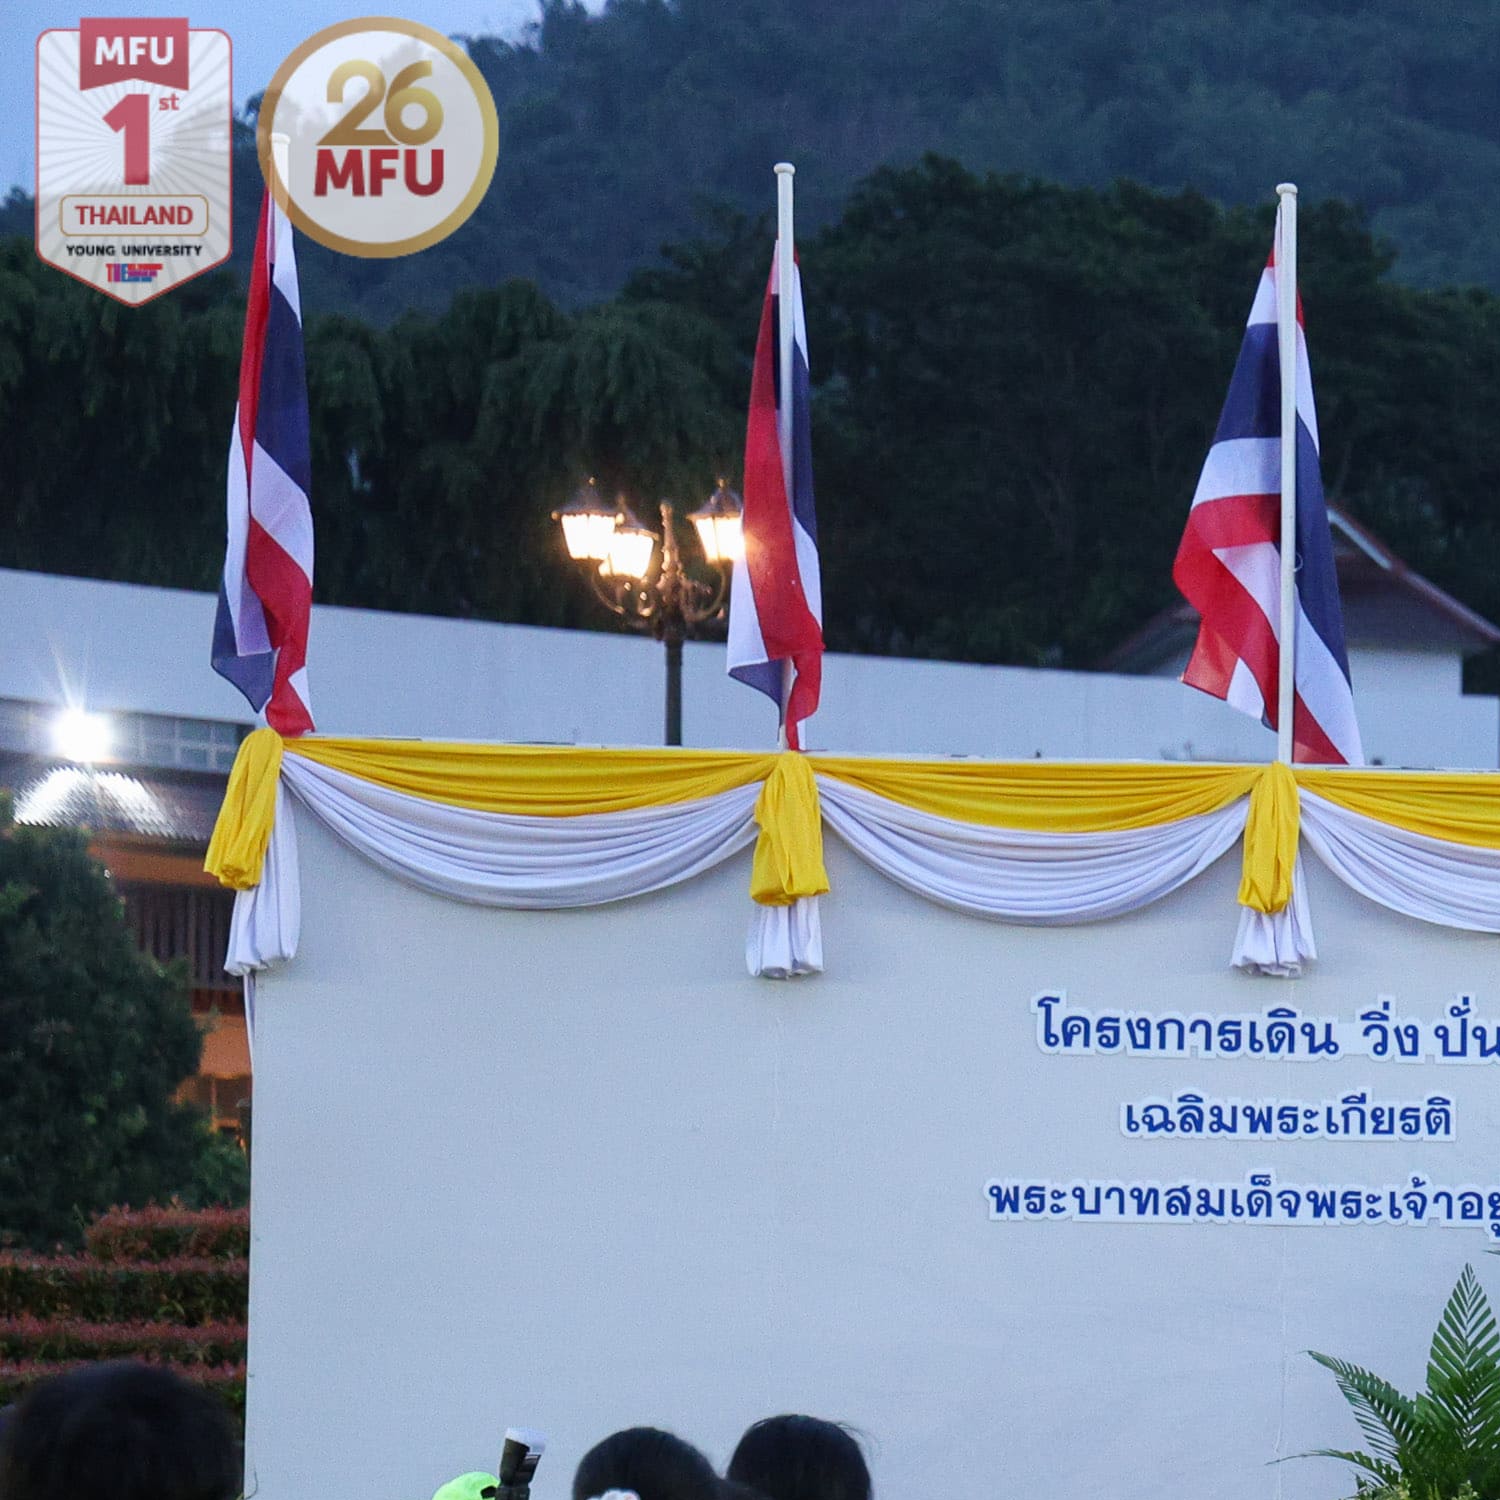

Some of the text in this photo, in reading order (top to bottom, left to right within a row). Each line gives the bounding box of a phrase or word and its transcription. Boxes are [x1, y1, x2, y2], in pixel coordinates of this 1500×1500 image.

[1036, 996, 1340, 1055] โครงการเดิน
[1359, 1001, 1420, 1057] วิ่ง
[1125, 1092, 1452, 1137] เฉลิมพระเกียรติ
